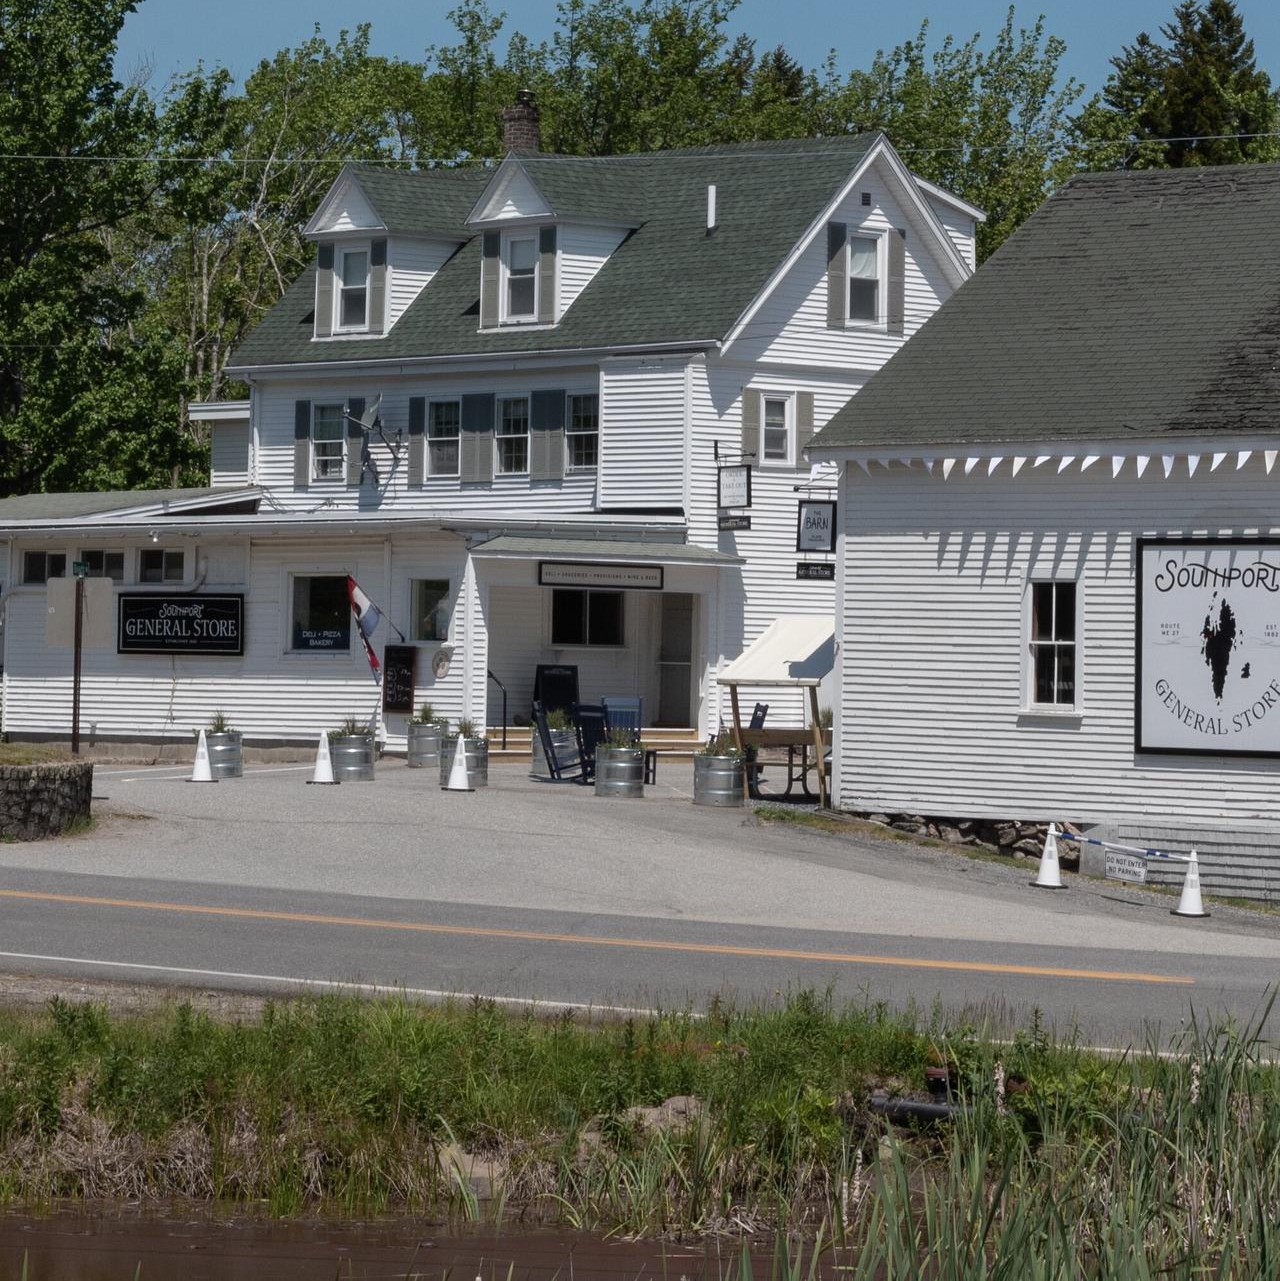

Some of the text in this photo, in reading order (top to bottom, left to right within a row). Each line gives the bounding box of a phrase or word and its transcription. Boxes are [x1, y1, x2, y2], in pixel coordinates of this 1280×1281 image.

[806, 517, 829, 531] BARN
[158, 603, 205, 619] SOUTHPORT
[126, 618, 238, 637] GENERAL STORE
[1155, 678, 1228, 735] GENERAL
[1116, 858, 1126, 866] NOT
[1118, 868, 1141, 877] PARKING
